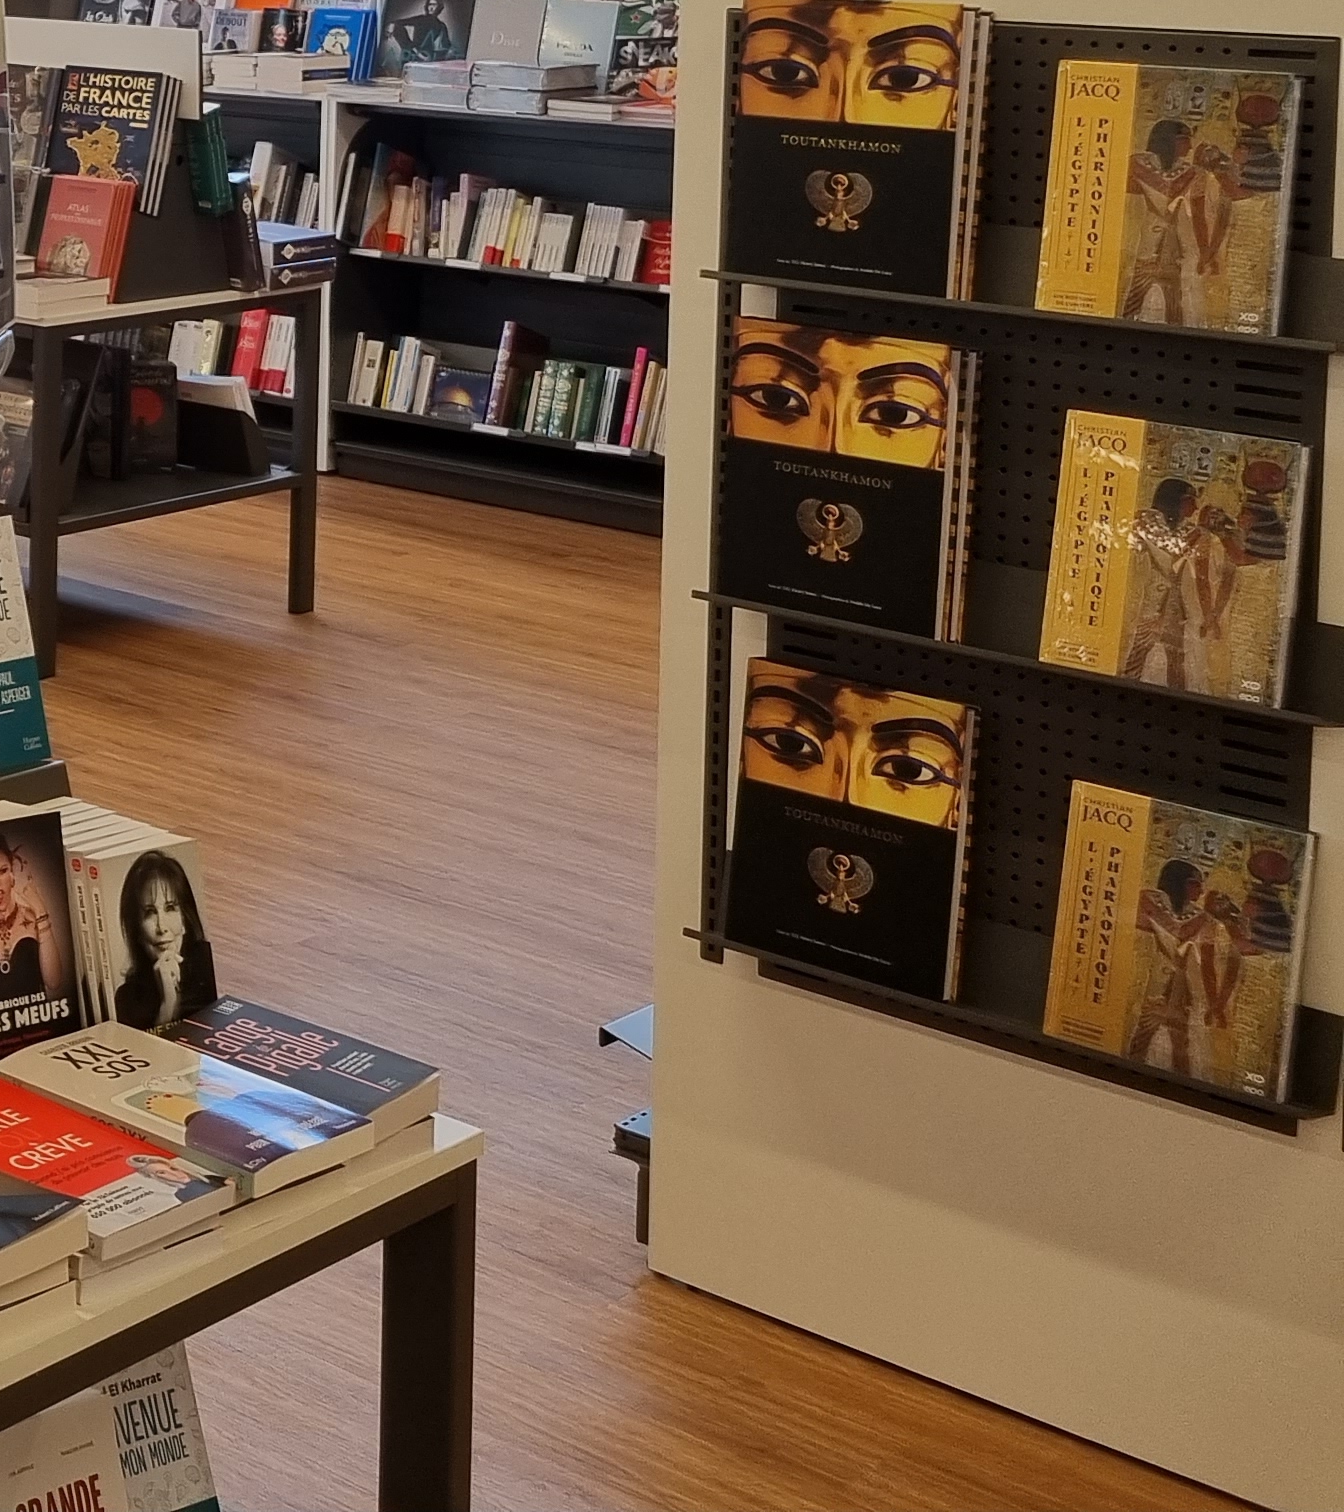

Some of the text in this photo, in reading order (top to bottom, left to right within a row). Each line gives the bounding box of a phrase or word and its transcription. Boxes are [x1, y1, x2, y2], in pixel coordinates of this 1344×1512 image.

[80, 72, 156, 90] L'HISTOIRE
[1069, 73, 1121, 86] CHRISTIAN
[63, 87, 152, 108] DE FRANCE
[1068, 80, 1121, 104] JACQ
[61, 102, 150, 121] PAR LES CARTES
[780, 133, 902, 154] TOUTANKHAMON
[50, 1040, 130, 1072] XXL
[92, 1054, 152, 1080] SOS
